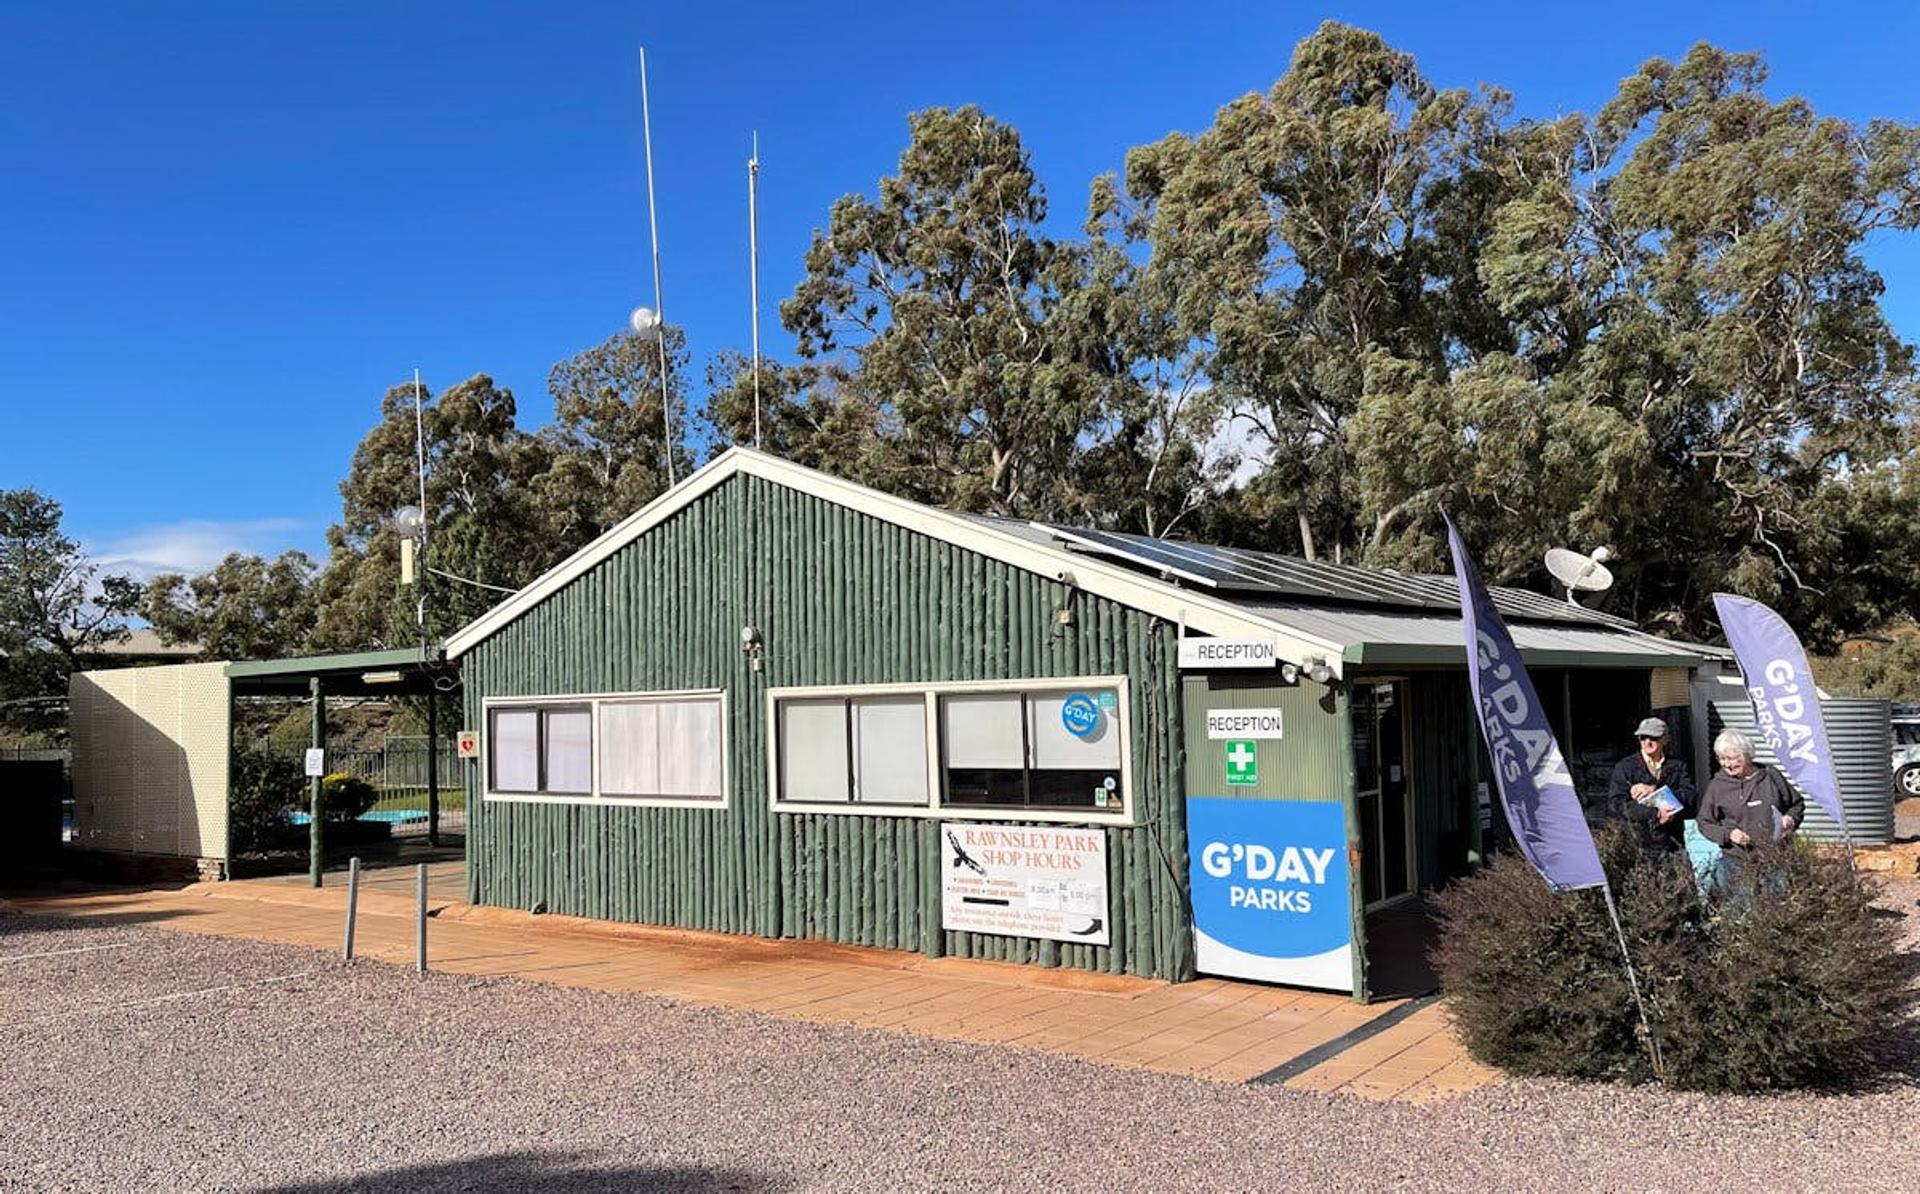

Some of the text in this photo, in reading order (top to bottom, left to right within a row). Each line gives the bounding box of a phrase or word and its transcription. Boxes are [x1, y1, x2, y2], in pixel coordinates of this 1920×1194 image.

[1198, 644, 1274, 659] RECEPTION
[1209, 716, 1280, 731] RECEPTION
[1749, 686, 1782, 750] PARKS
[1765, 658, 1819, 764] G'DAY
[1480, 690, 1522, 784] ARKS
[965, 829, 1099, 853] RAWNSLEY PARK
[983, 849, 1082, 871] SHOP HOURS
[1201, 841, 1335, 885] G'DAY
[1230, 887, 1312, 913] PARKS
